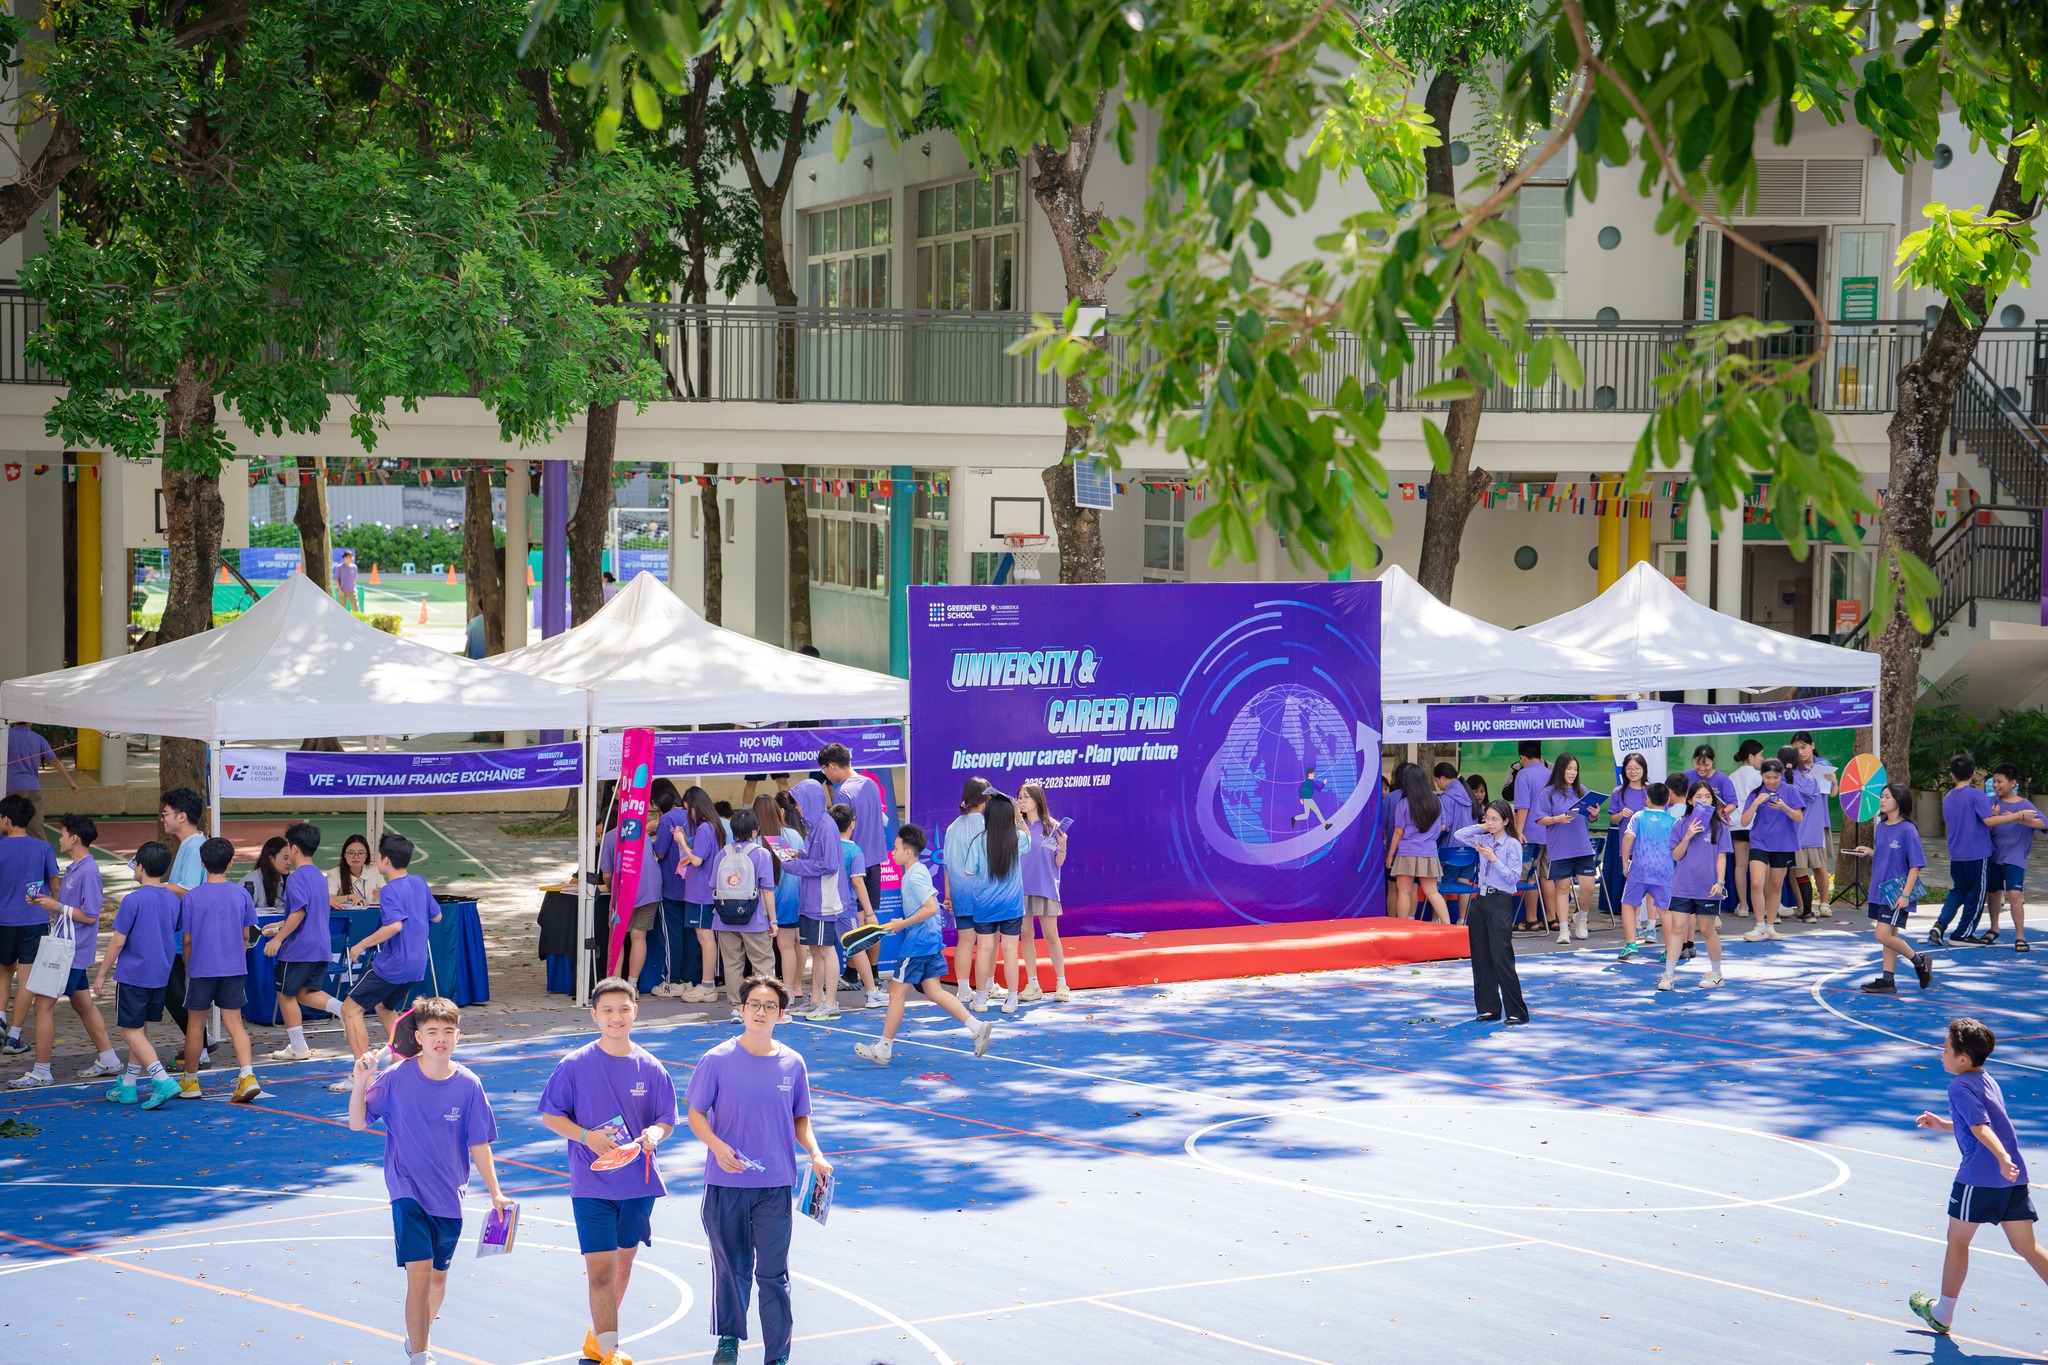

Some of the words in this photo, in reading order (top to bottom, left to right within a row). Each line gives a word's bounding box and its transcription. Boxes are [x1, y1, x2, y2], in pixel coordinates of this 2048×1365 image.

[952, 650, 1079, 687] UNIVERSITY
[1078, 650, 1097, 683] &
[1048, 698, 1129, 735] CAREER
[1130, 696, 1178, 731] FAIR
[1703, 711, 1728, 725] QUẦY
[1728, 711, 1760, 724] THÔNG
[1760, 711, 1777, 722] TIN
[1784, 707, 1800, 720] ĐỔI
[1801, 706, 1822, 720] QUÀ
[1454, 721, 1470, 732] ĐẠI
[1472, 720, 1491, 732] HỌC
[1493, 719, 1544, 730] GREENWICH
[1546, 718, 1584, 729] VIETNAM
[1617, 725, 1651, 738] UNIVERSITY
[1653, 724, 1661, 734] OF
[740, 737, 760, 749] HỌC
[762, 735, 783, 748] VIỆN
[1619, 736, 1662, 751] GREENWICH
[666, 752, 694, 766] THIẾT
[697, 752, 709, 765] KẾ
[711, 752, 724, 764] VÀ
[726, 752, 748, 764] THỜI
[750, 752, 781, 763] TRANG
[784, 751, 820, 762] LONDON
[952, 750, 1007, 770] Discover
[1006, 751, 1036, 771] your
[1037, 749, 1078, 765] career
[1085, 744, 1111, 764] Plan
[1111, 746, 1141, 766] your
[1141, 742, 1178, 760] future
[309, 774, 335, 786] VFE
[346, 774, 405, 786] VIETNAM
[408, 772, 458, 785] FRANCE
[460, 768, 526, 783] EXCHANGE
[1064, 775, 1091, 787] SCHOOL
[1092, 774, 1111, 786] YEAR
